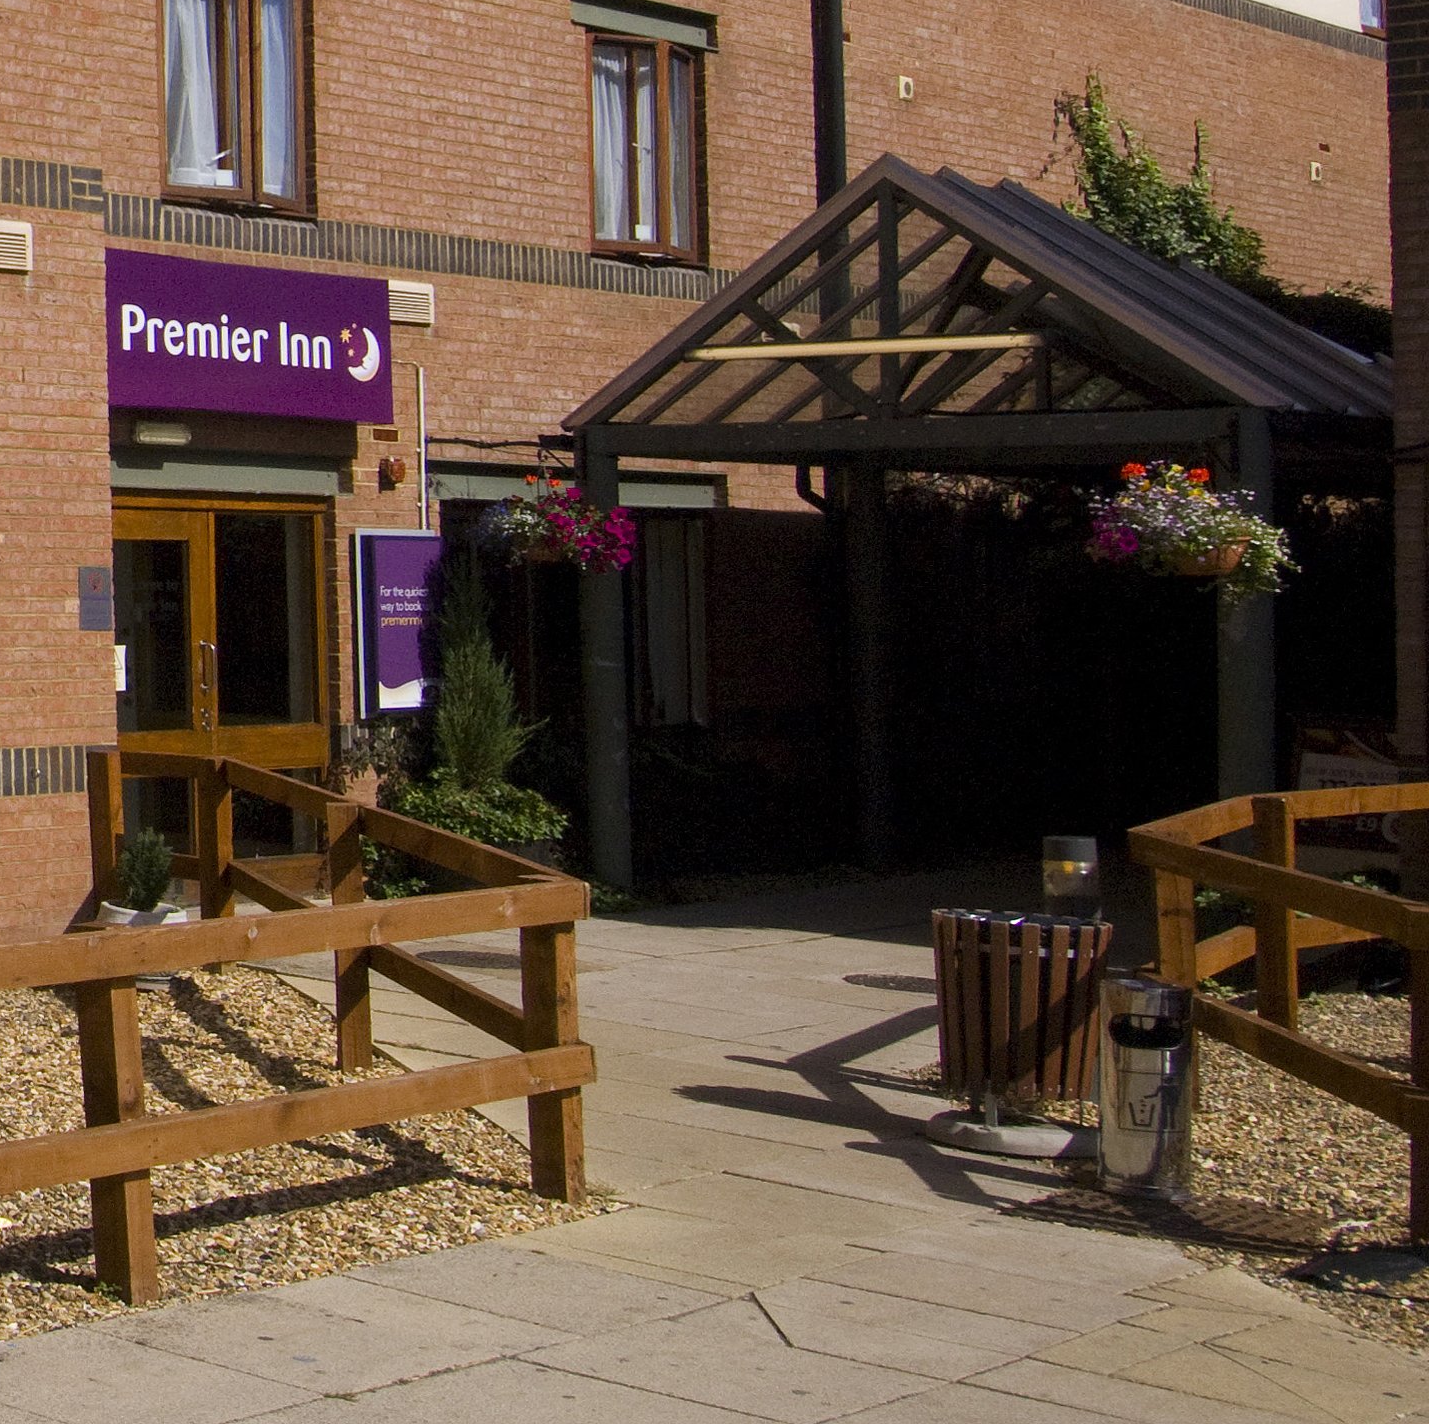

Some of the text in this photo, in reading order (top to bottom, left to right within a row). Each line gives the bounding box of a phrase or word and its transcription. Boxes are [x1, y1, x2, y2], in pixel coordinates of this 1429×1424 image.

[122, 304, 332, 370] Premier Inn
[380, 585, 391, 597] For
[392, 586, 404, 597] the
[380, 600, 423, 614] way to book
